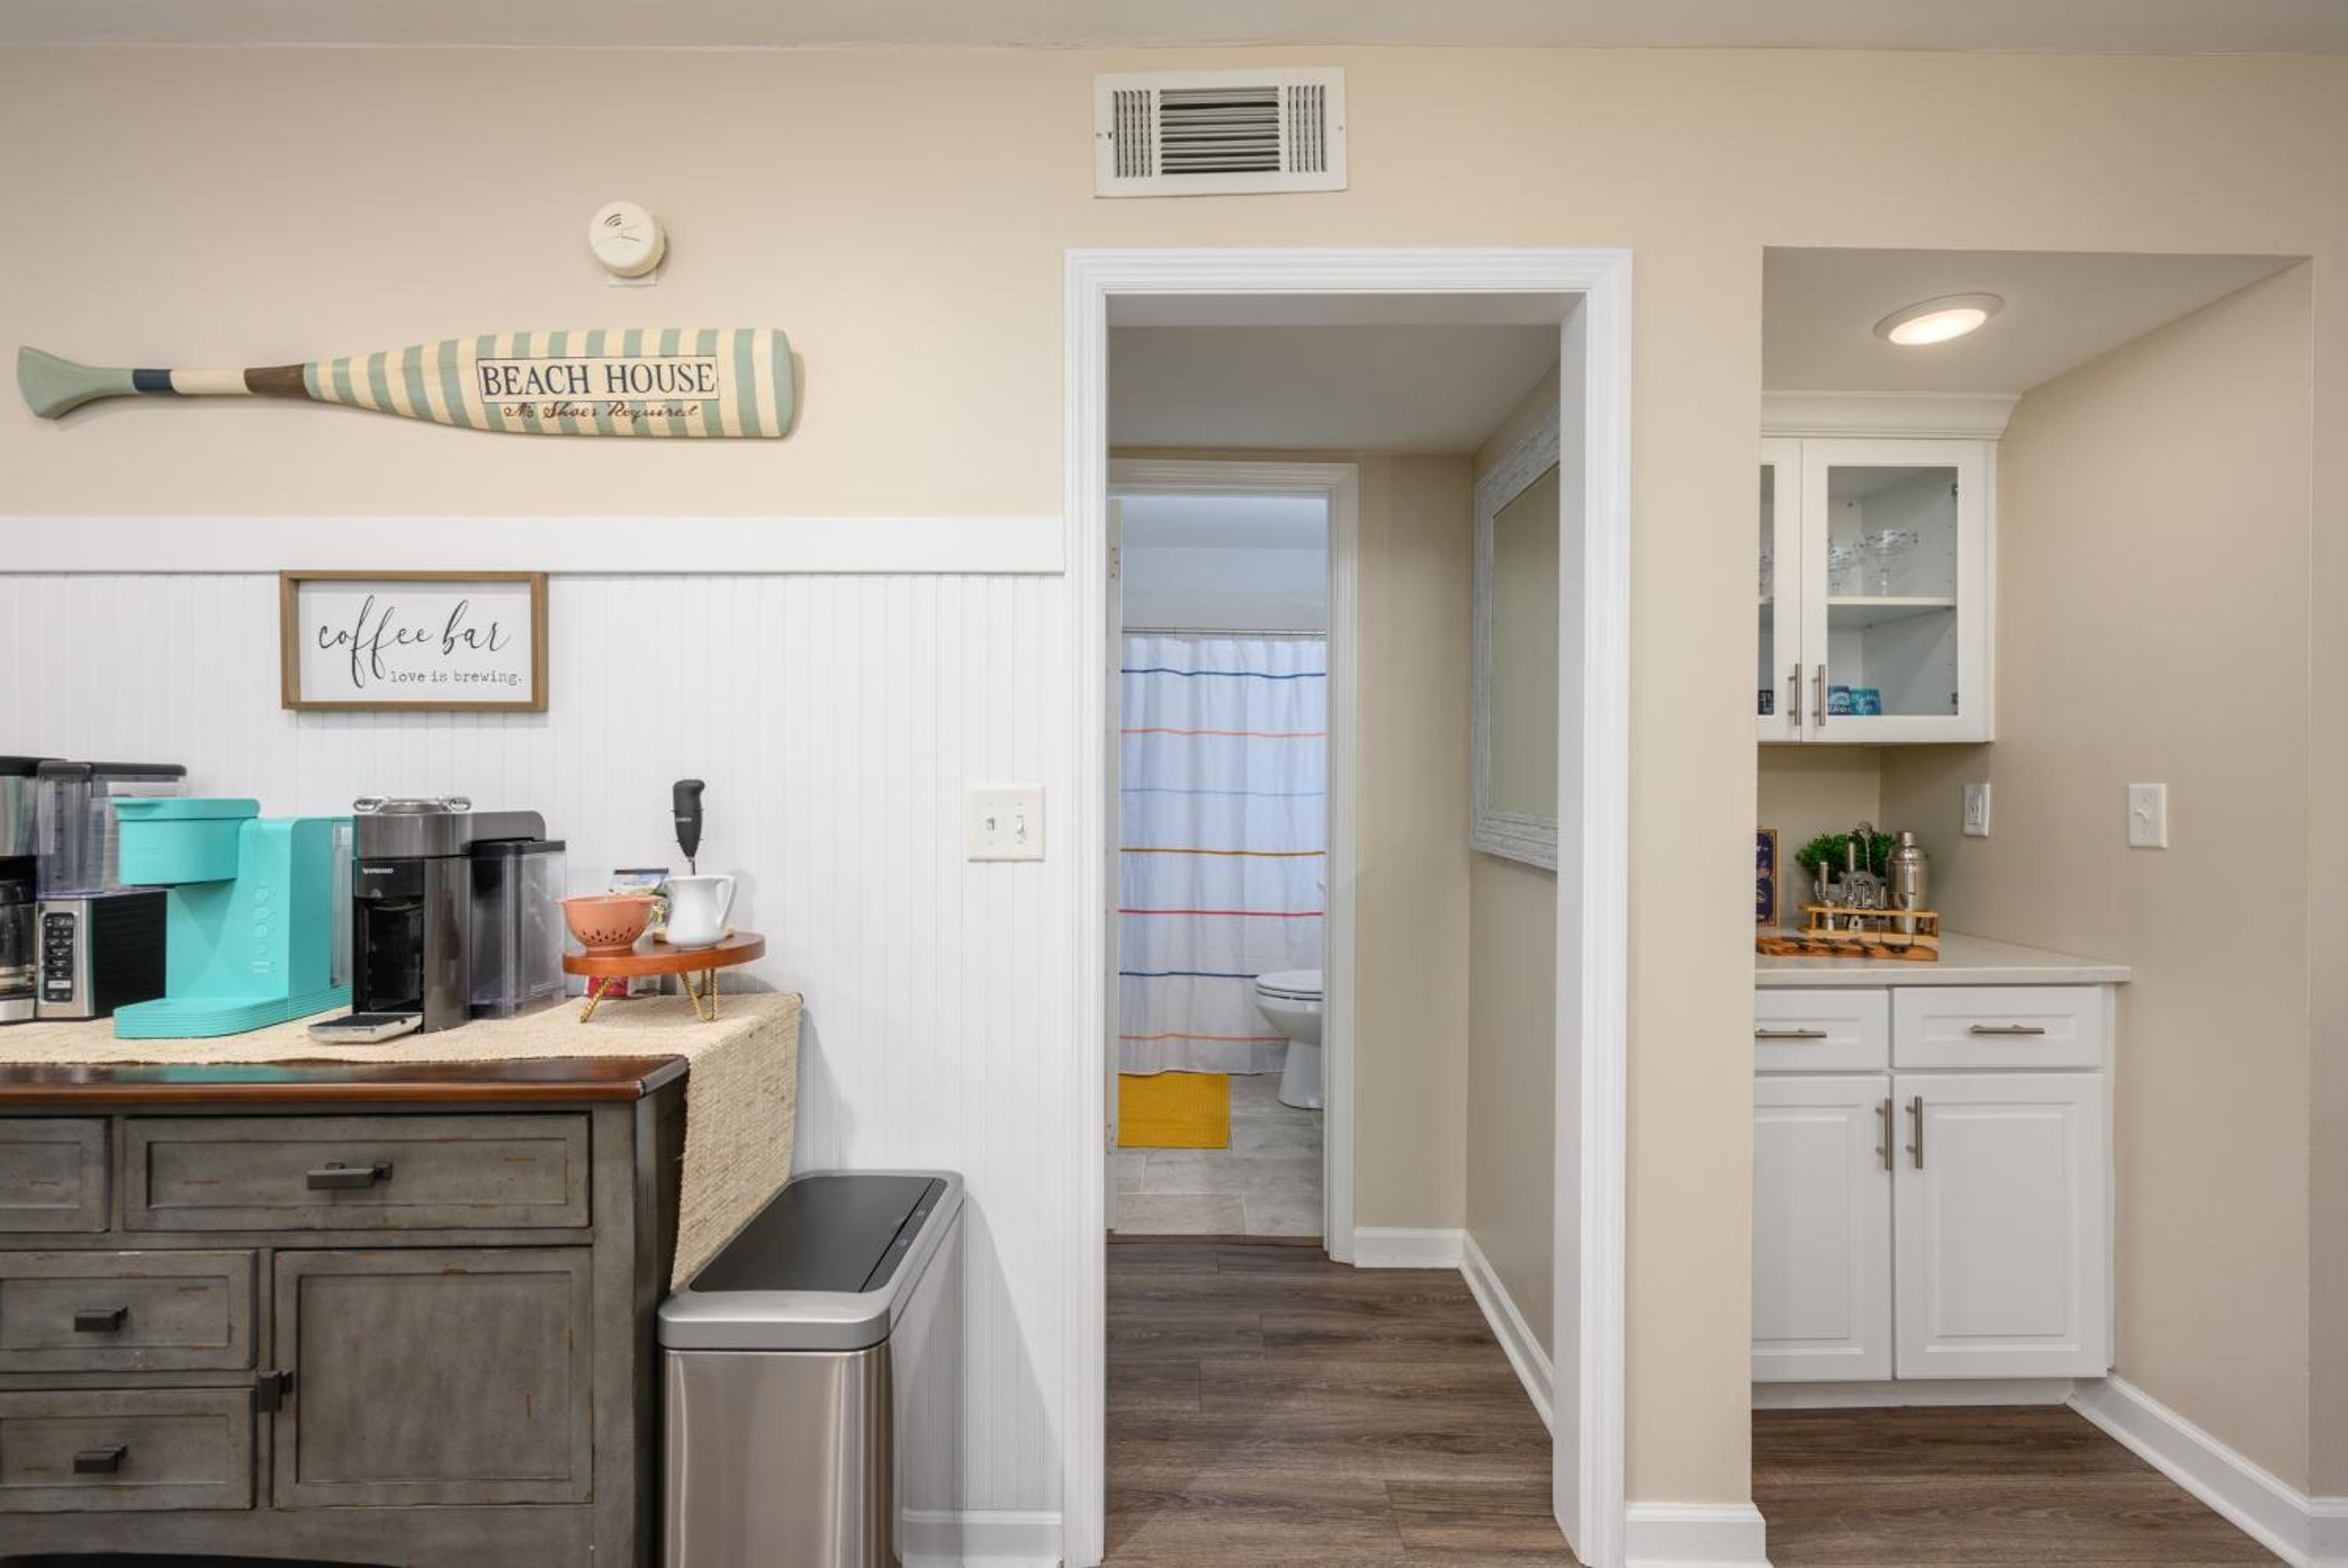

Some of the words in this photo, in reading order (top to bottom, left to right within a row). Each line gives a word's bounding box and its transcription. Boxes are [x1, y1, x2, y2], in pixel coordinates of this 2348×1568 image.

[481, 364, 591, 396] BEACH
[605, 363, 715, 393] HOUSE
[503, 401, 535, 418] No
[542, 401, 598, 419] Shoes
[607, 401, 699, 423] Required
[319, 595, 432, 689] coffee
[442, 599, 510, 655] bar
[390, 671, 426, 683] love
[432, 671, 448, 682] is
[453, 671, 522, 685] brewing.
